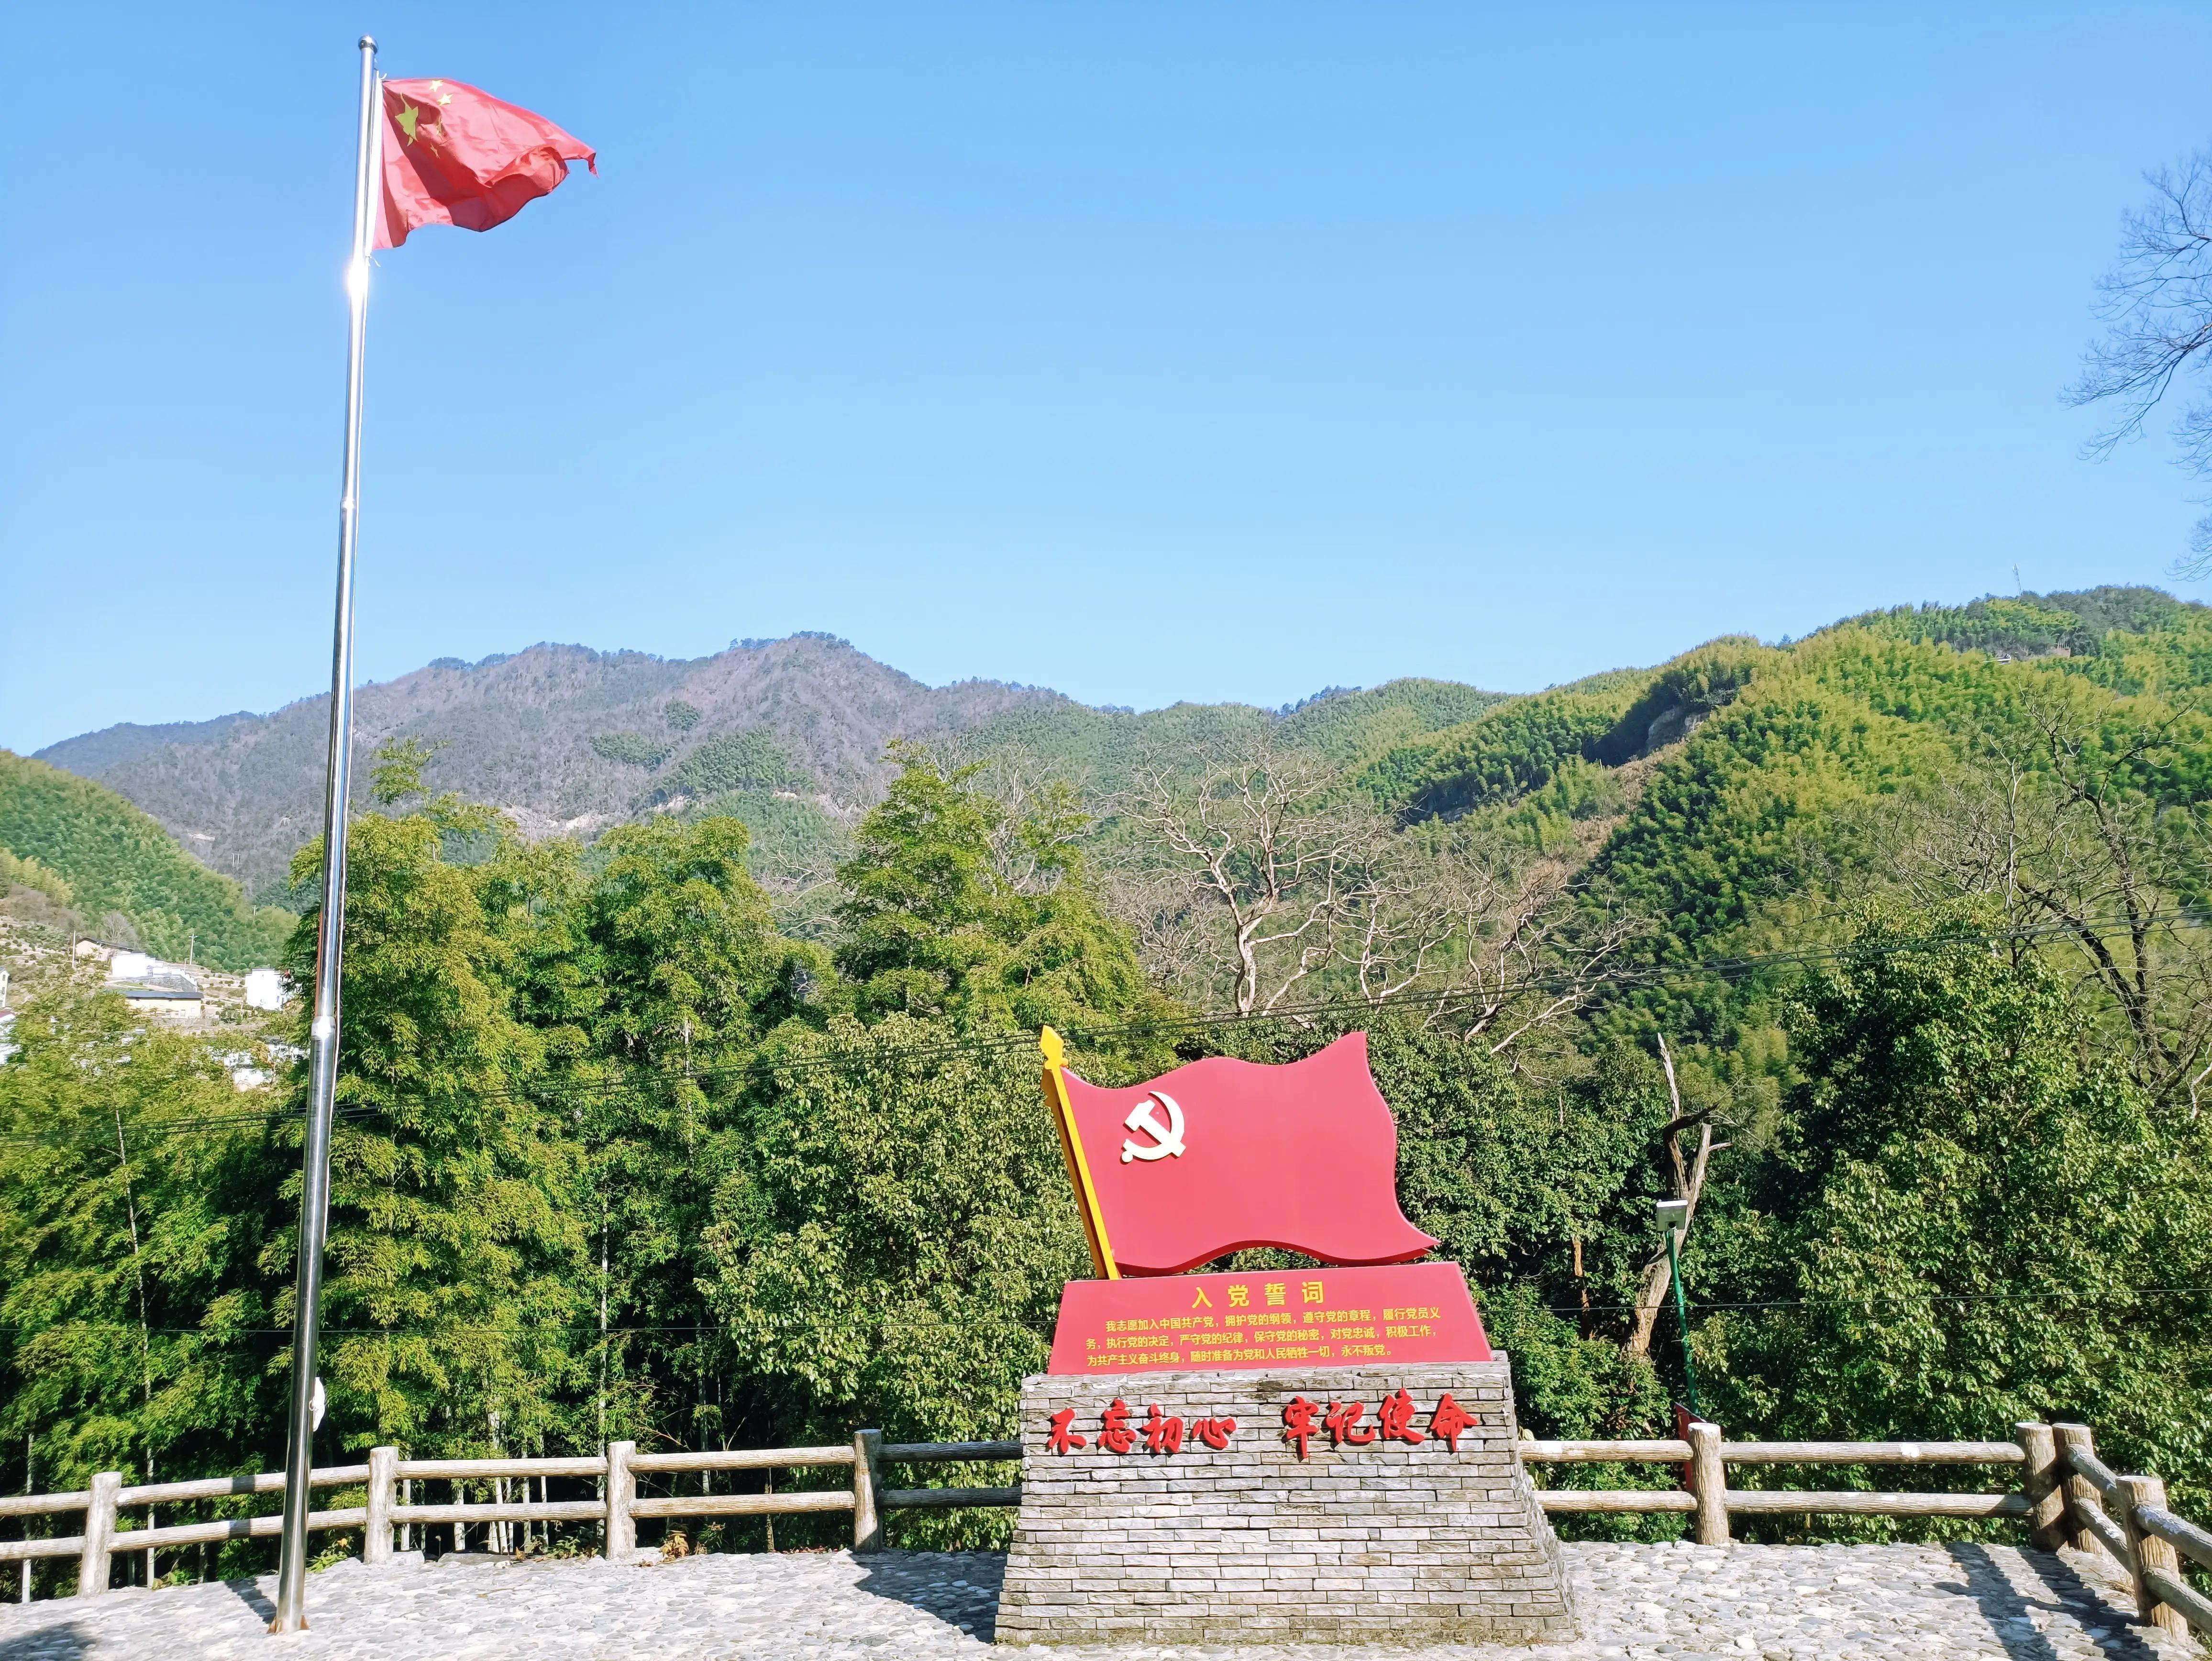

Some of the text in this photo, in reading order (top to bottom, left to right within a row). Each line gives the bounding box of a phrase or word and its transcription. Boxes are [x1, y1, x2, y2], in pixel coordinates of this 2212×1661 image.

[1191, 1281, 1325, 1309] 入党誓词
[1106, 1307, 1441, 1332] 我志愿加入中国共产党，拥护党的纲领，遵守党的章程，履行党员义
[1086, 1324, 1437, 1351] 务，执行党的决定，严守党的纪律，保守党的秘密，对党忠诚，积极工作，
[1086, 1343, 1393, 1367] 为共产主义奋斗终身，随时准备为党和人民牺牲一切，永不叛党。
[1047, 1387, 1478, 1459] 不忘初心 牢记使命
